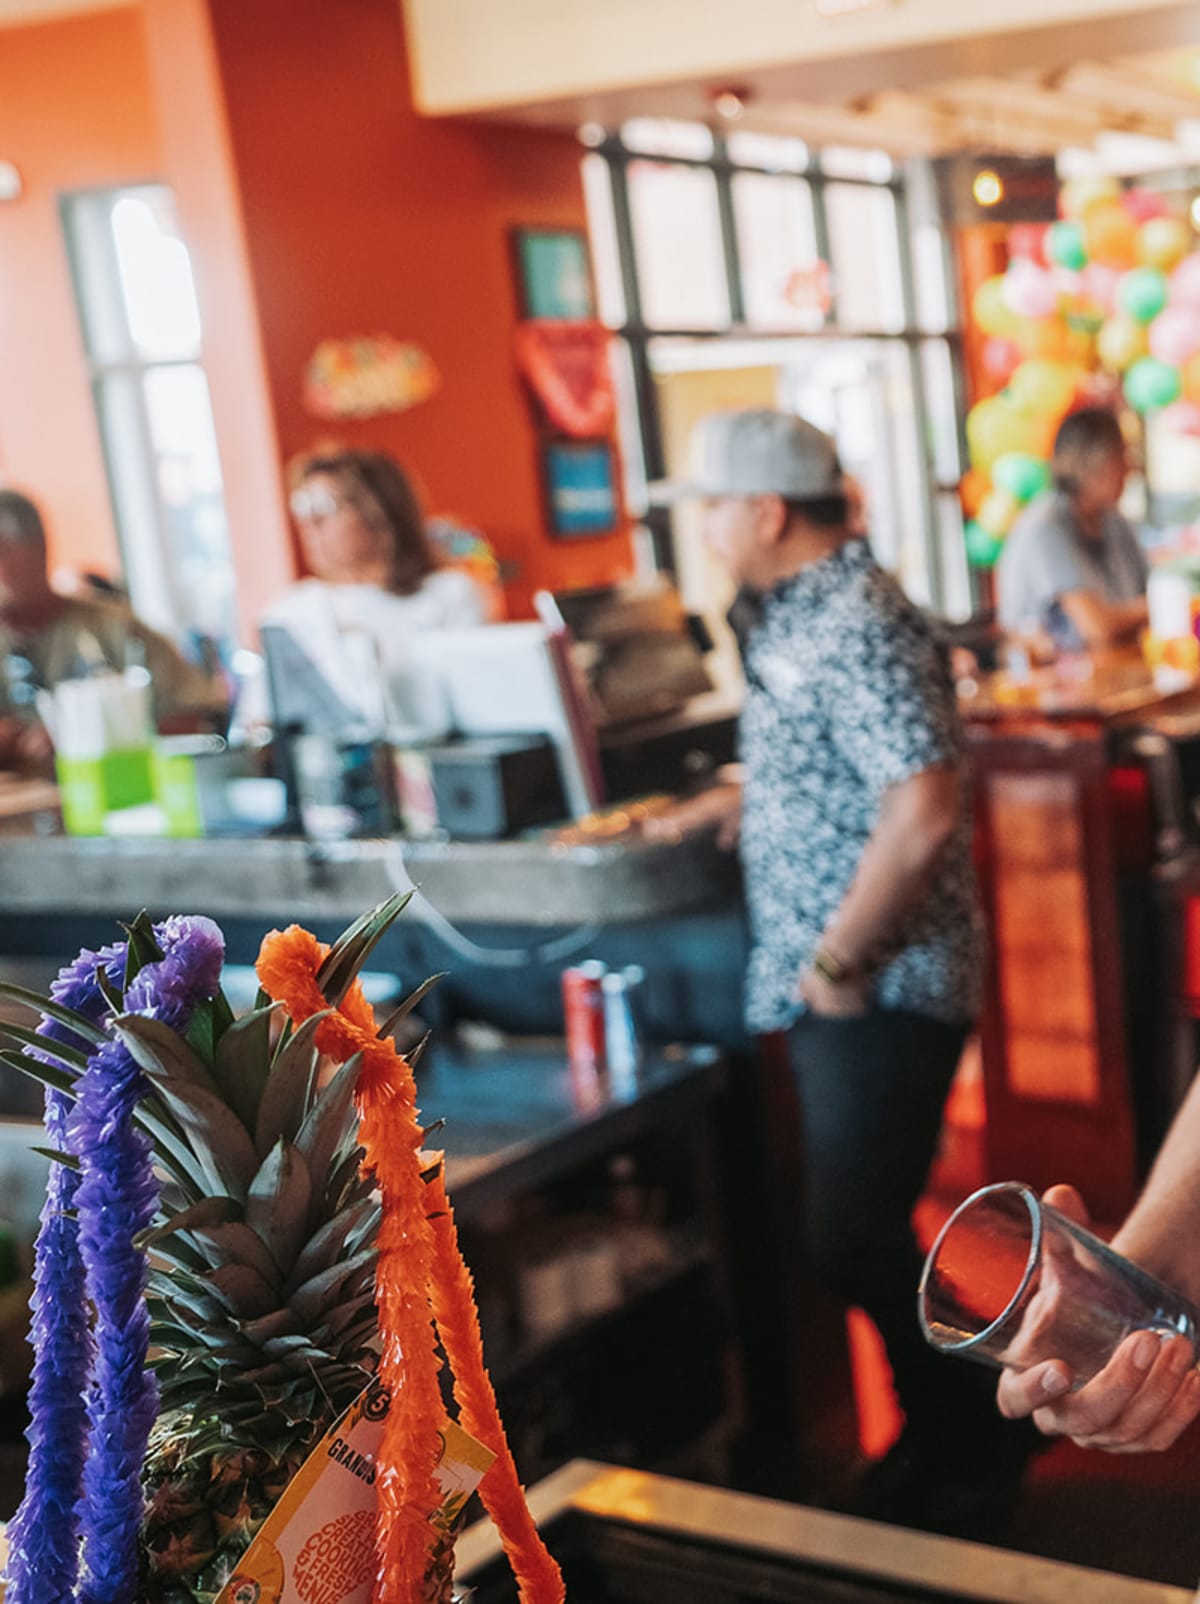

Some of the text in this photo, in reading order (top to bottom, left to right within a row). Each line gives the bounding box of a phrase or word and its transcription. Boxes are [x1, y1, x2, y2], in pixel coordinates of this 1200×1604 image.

[371, 1393, 389, 1412] 5
[305, 1532, 373, 1584] COOKING
[308, 1558, 358, 1596] FRESH
